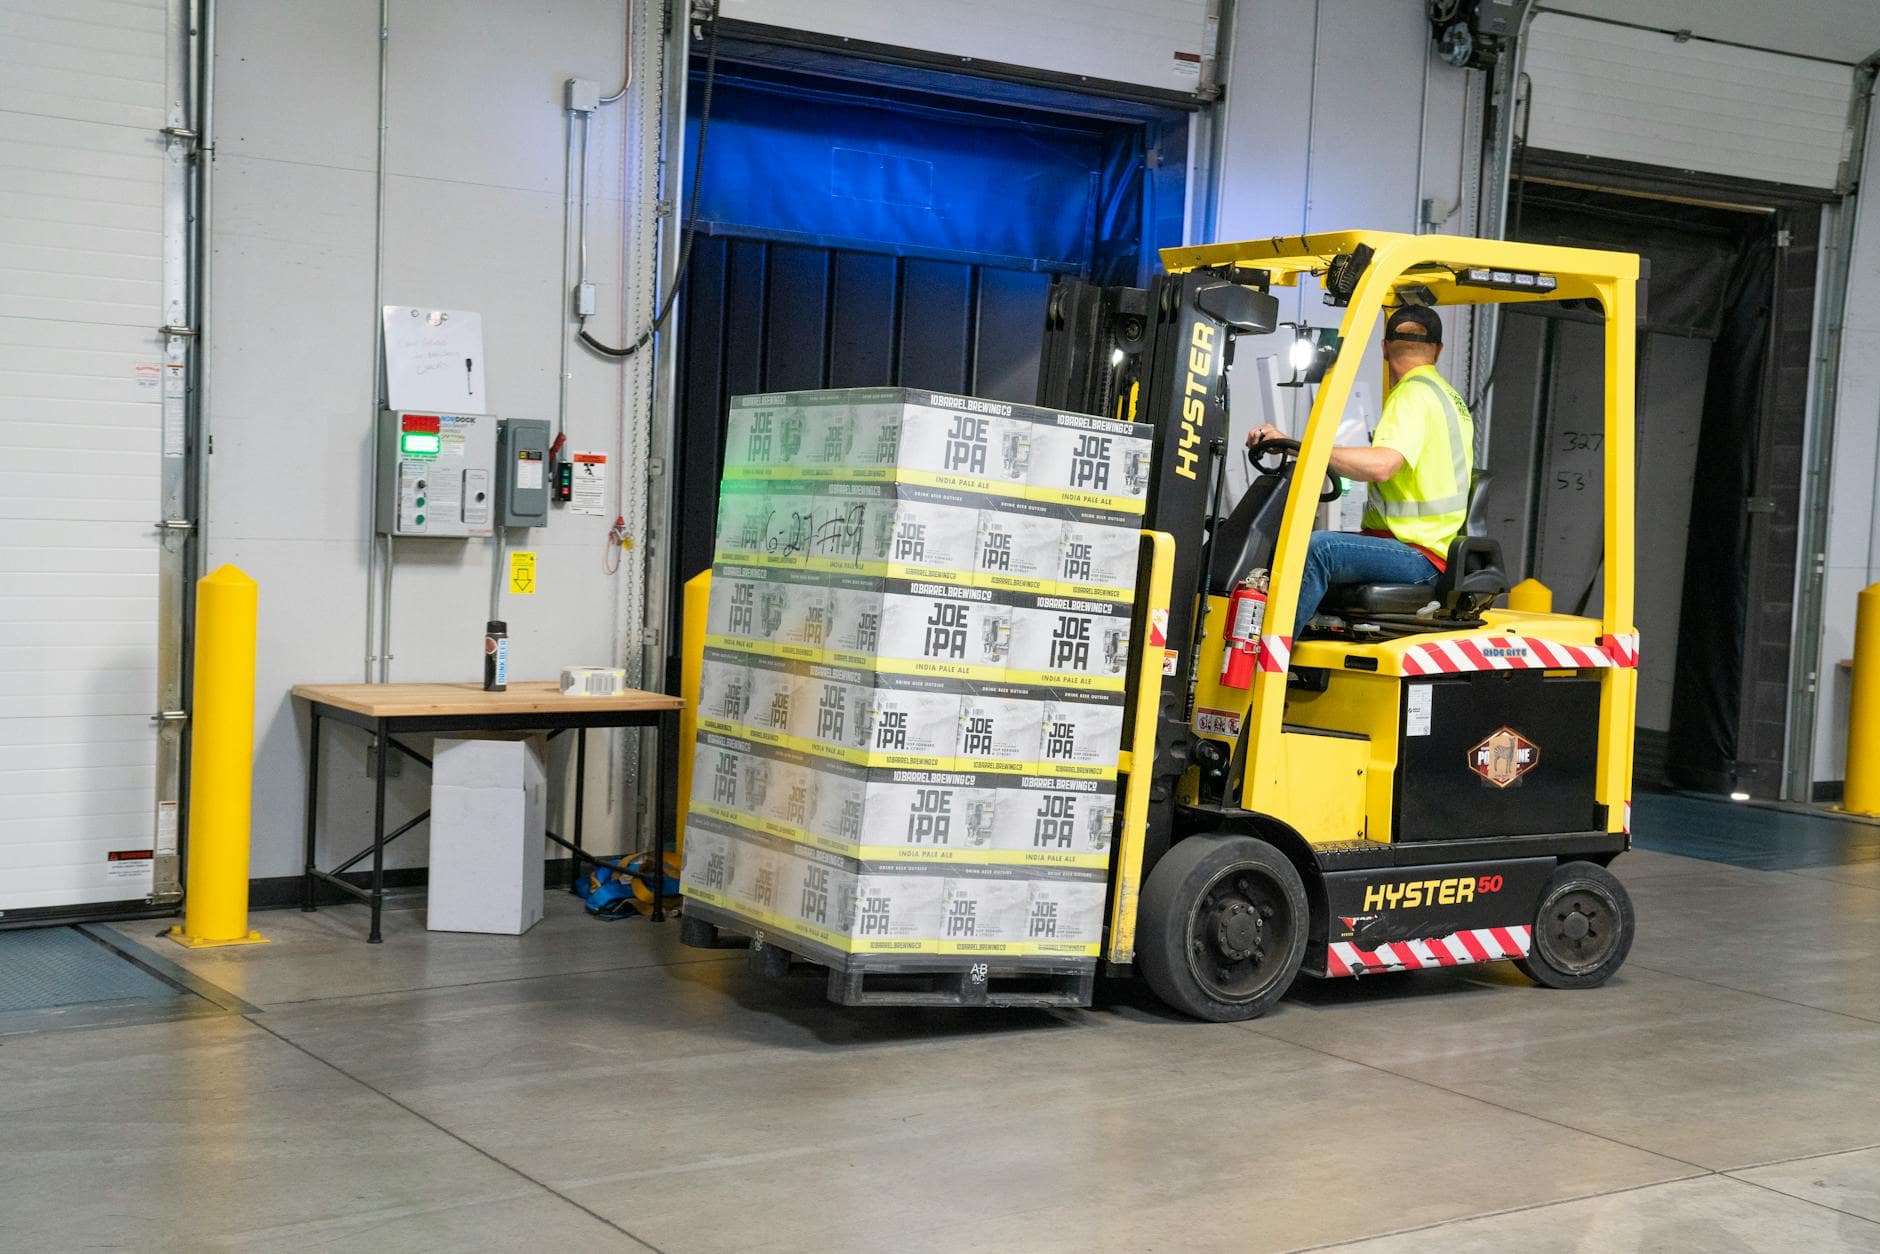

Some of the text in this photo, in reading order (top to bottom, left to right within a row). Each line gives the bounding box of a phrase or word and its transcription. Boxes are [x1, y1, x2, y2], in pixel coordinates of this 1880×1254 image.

[1176, 322, 1214, 480] HYSTER
[750, 412, 773, 433] JOE
[948, 416, 990, 442] JOE
[825, 427, 843, 441] JOE
[879, 426, 898, 442] JOE
[1562, 432, 1604, 451] 327
[748, 435, 771, 462] IPA
[824, 443, 842, 462] IPA
[876, 443, 896, 463] IPA
[944, 440, 988, 474] IPA
[1074, 435, 1112, 461] JOE
[936, 476, 956, 485] INDIA
[1070, 459, 1109, 490] IPA
[1062, 493, 1081, 501] INDIA
[897, 522, 926, 541] JOE
[985, 532, 1012, 550] JOE
[896, 540, 924, 562] IPA
[982, 549, 1010, 571] IPA
[1066, 543, 1092, 560] JOE
[1064, 560, 1090, 580] IPA
[732, 583, 754, 605] JOE
[729, 605, 752, 634] IPA
[806, 607, 823, 623] JOE
[859, 614, 877, 630] JOE
[928, 603, 970, 629] JOE
[803, 623, 822, 644] IPA
[1053, 616, 1091, 640] JOE
[856, 630, 876, 651] IPA
[924, 628, 966, 659] IPA
[1050, 640, 1088, 670] IPA
[1483, 648, 1526, 656] RIDE RITE
[916, 663, 936, 671] INDIA
[725, 684, 741, 700] JOE
[772, 693, 789, 709] JOE
[820, 685, 846, 710] JOE
[724, 700, 739, 720] IPA
[770, 709, 788, 729] IPA
[817, 709, 843, 741] IPA
[879, 712, 908, 729] JOE
[966, 718, 993, 734] JOE
[1049, 722, 1075, 739] JOE
[877, 728, 906, 749] IPA
[964, 734, 992, 754] IPA
[1047, 739, 1073, 759] IPA
[716, 752, 738, 777] JOE
[714, 774, 736, 805] IPA
[911, 790, 953, 813] JOE
[1038, 795, 1076, 818] JOE
[907, 814, 950, 844] IPA
[1034, 819, 1074, 848] IPA
[708, 853, 724, 871] JOE
[706, 870, 722, 890] IPA
[804, 865, 829, 893] JOE
[1363, 875, 1503, 912] HYSTER 50
[801, 888, 827, 923] IPA
[862, 898, 890, 913] JOE
[949, 900, 977, 916] JOE
[1032, 902, 1058, 917] JOE
[860, 915, 889, 935] IPA
[947, 917, 975, 936] IPA
[1030, 918, 1056, 936] IPA
